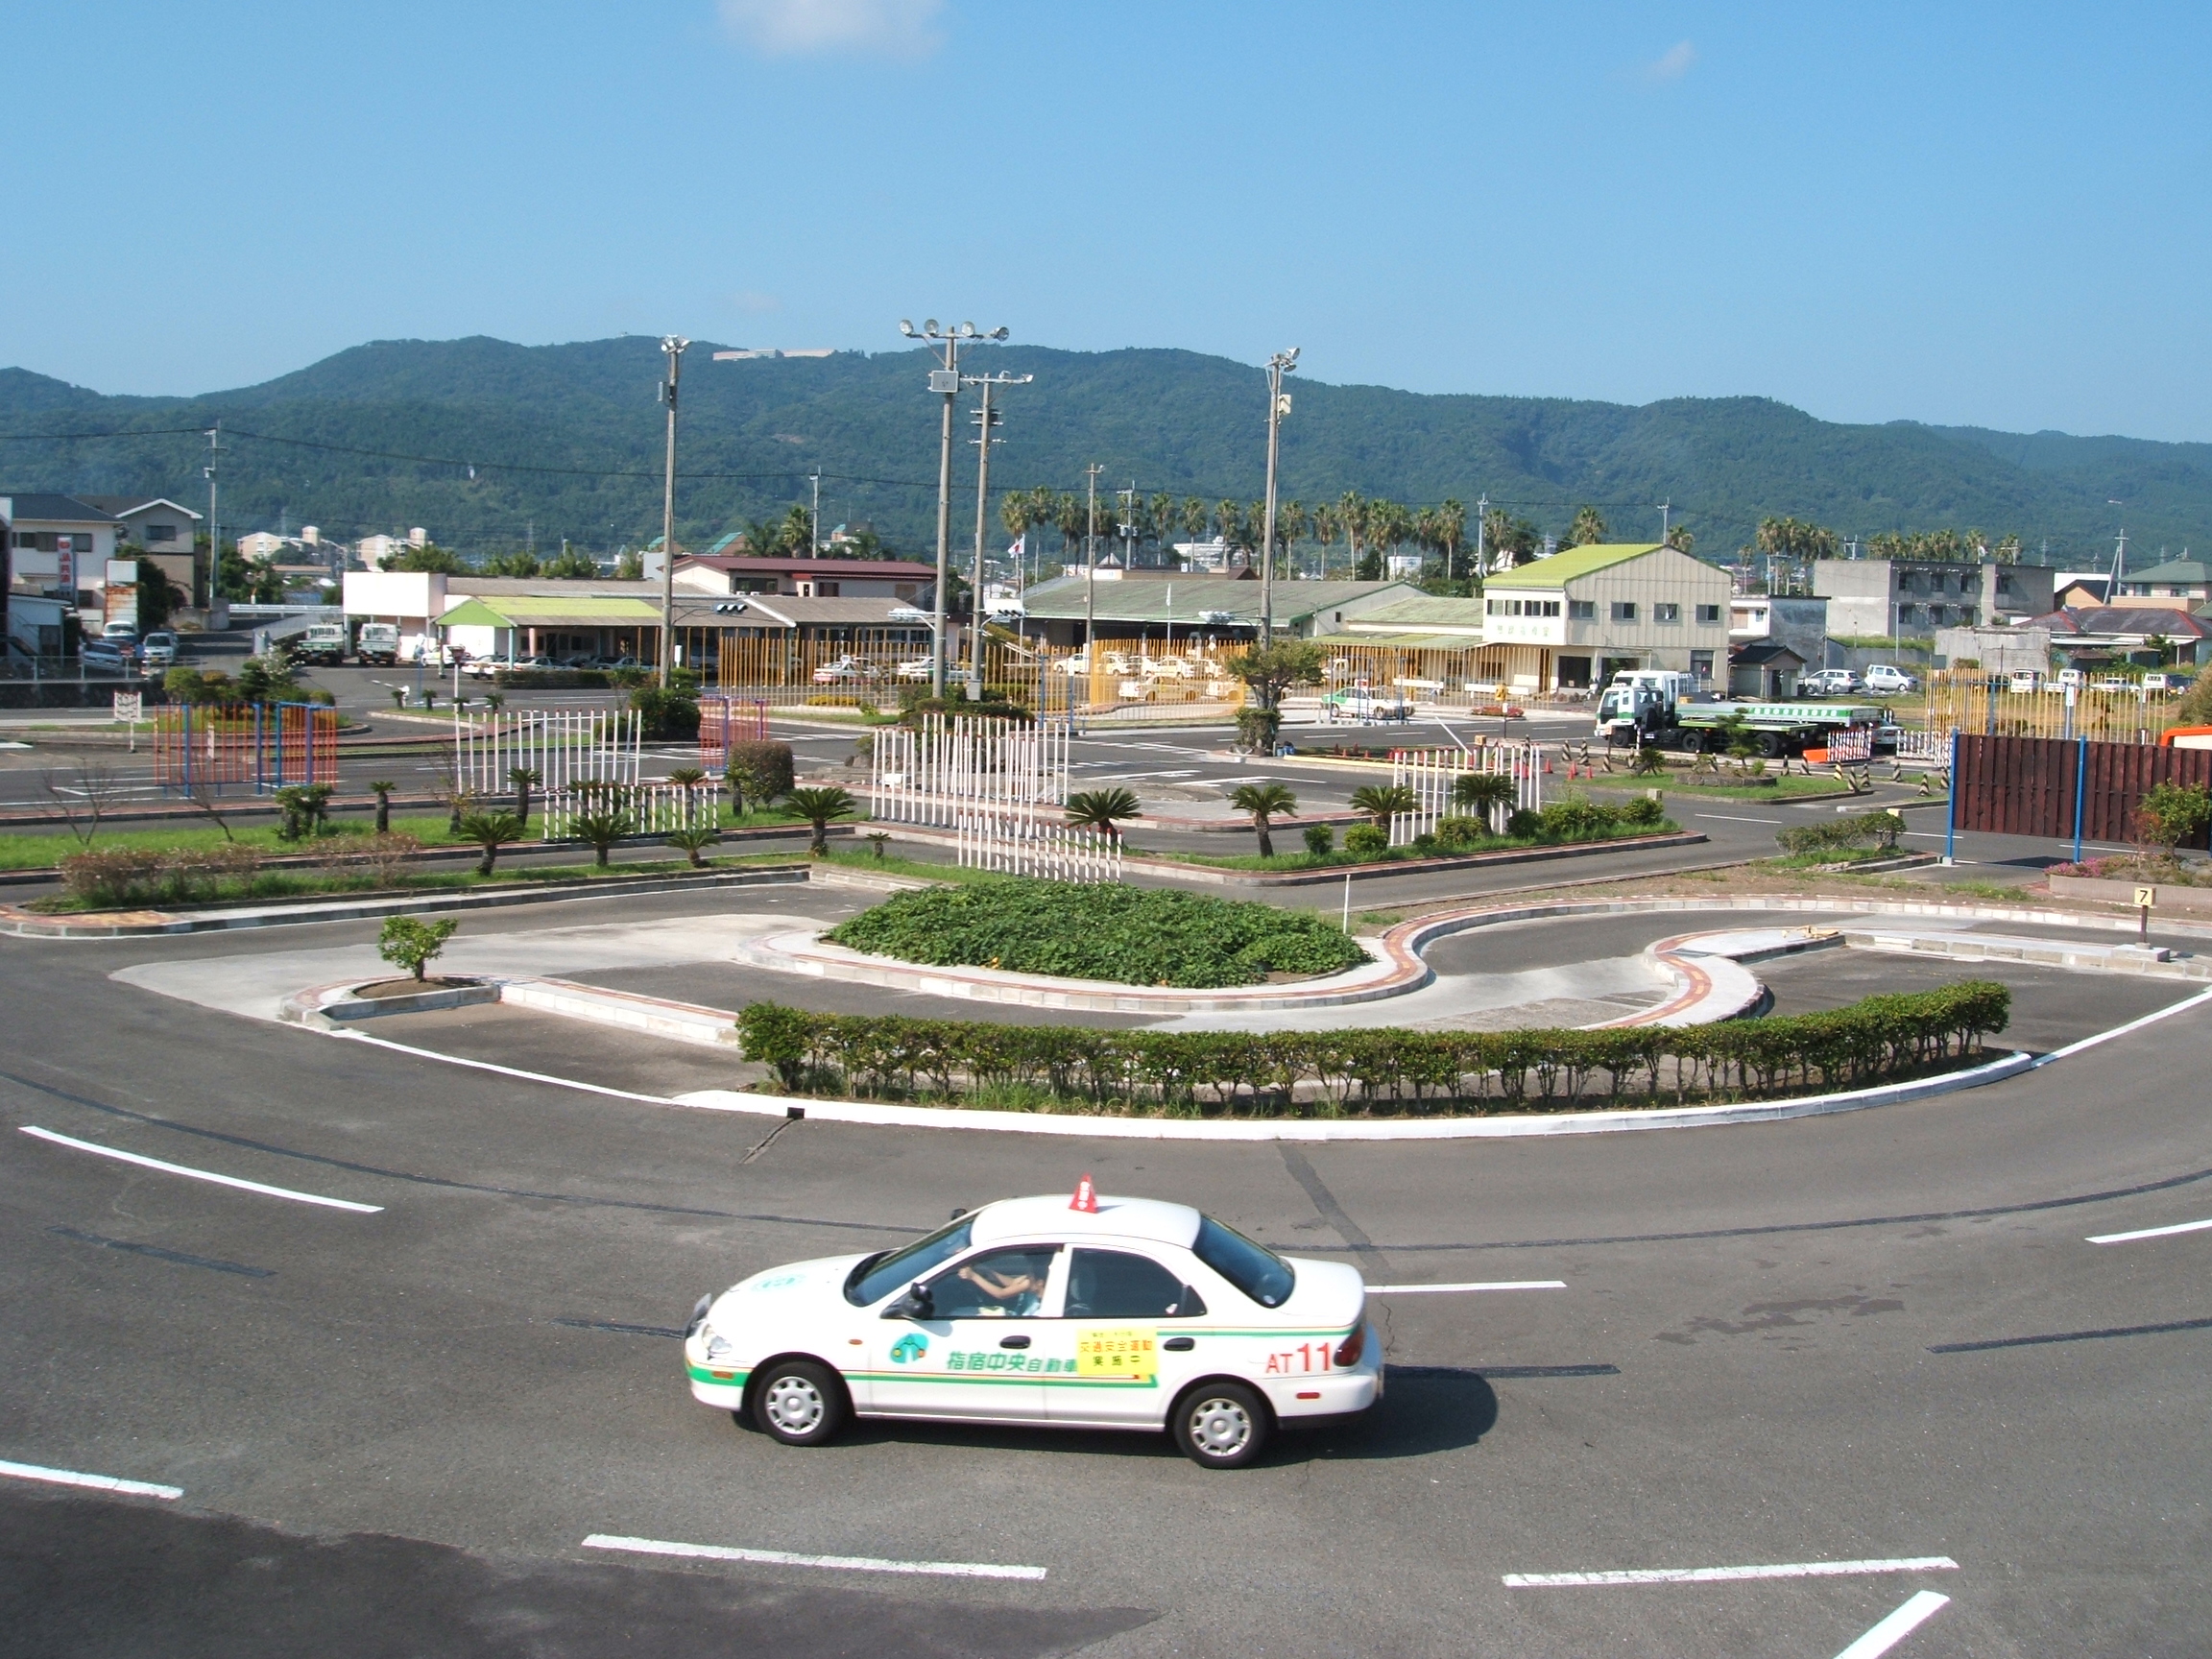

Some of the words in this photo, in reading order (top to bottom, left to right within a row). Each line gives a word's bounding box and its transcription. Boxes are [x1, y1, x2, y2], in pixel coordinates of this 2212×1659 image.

[2140, 889, 2149, 902] 7
[1080, 1338, 1153, 1354] 交通安全運動
